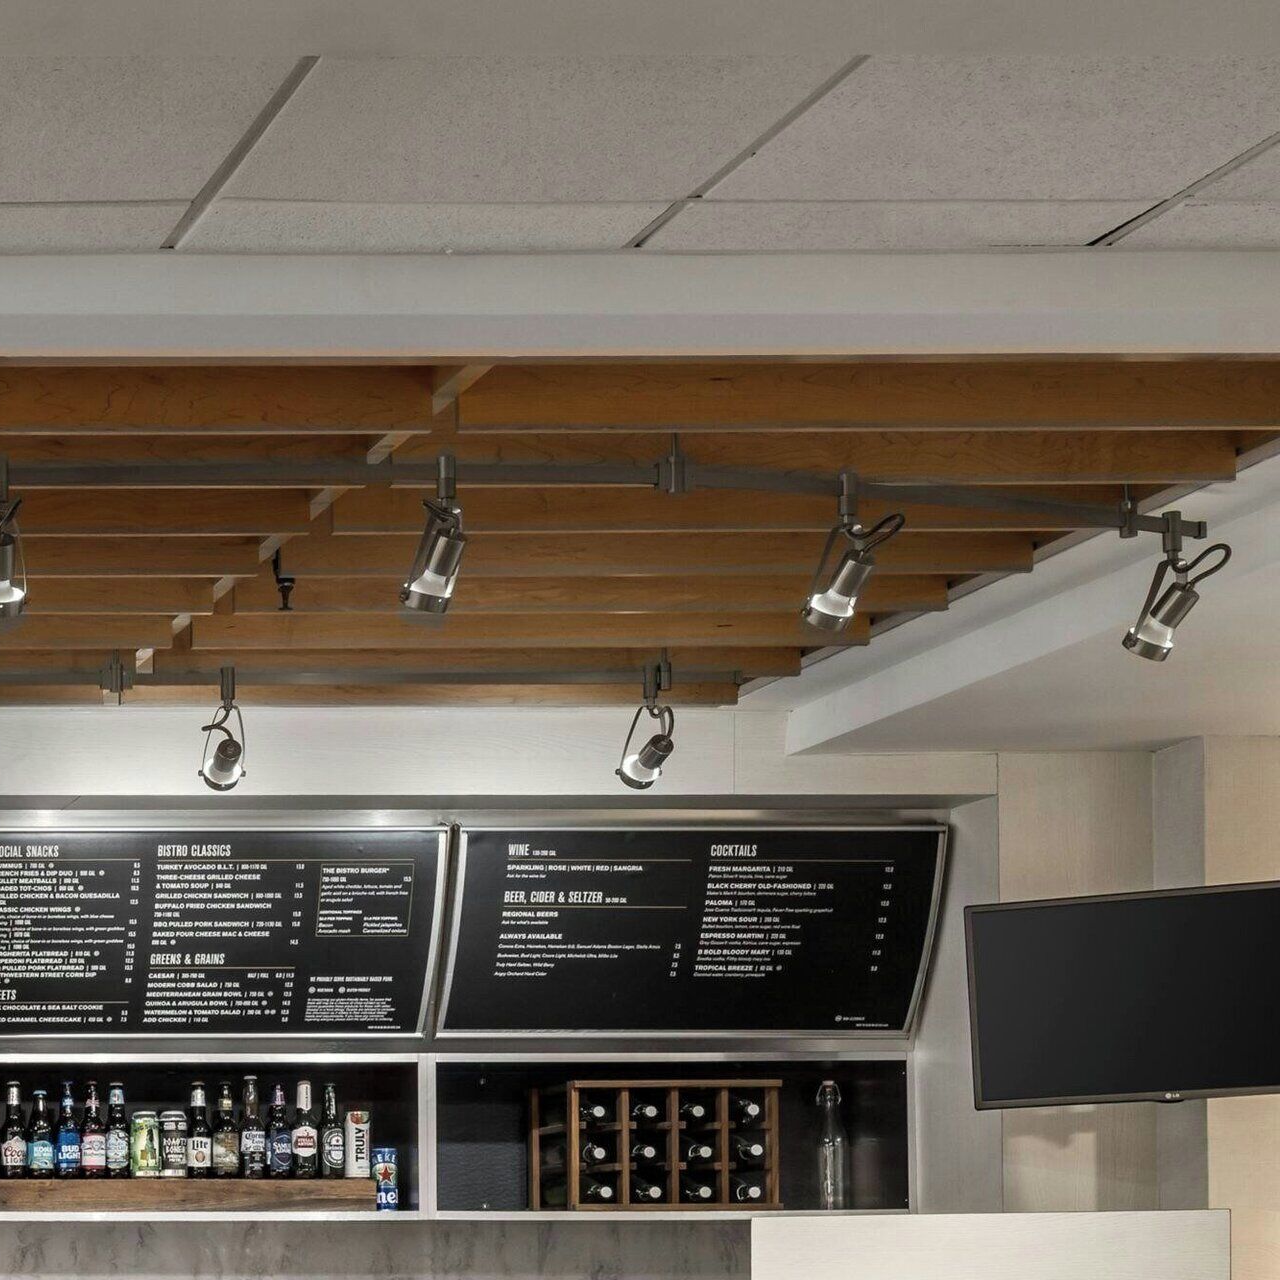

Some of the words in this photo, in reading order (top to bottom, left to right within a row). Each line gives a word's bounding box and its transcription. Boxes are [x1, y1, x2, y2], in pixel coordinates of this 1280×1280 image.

[26, 845, 59, 858] SNACKS
[157, 844, 188, 857] BISTRO
[191, 844, 231, 857] CLASSICS
[508, 844, 530, 856] WINE
[710, 845, 757, 857] COCKTAILS
[504, 891, 527, 903] BEER,
[530, 891, 555, 903] CIDER
[558, 891, 565, 903] &
[568, 891, 603, 903] SELTZER
[150, 953, 181, 965] GREENS
[184, 953, 191, 965] &
[194, 953, 225, 965] GRAINS
[191, 1140, 209, 1150] Lite
[355, 1127, 365, 1162] TRULY
